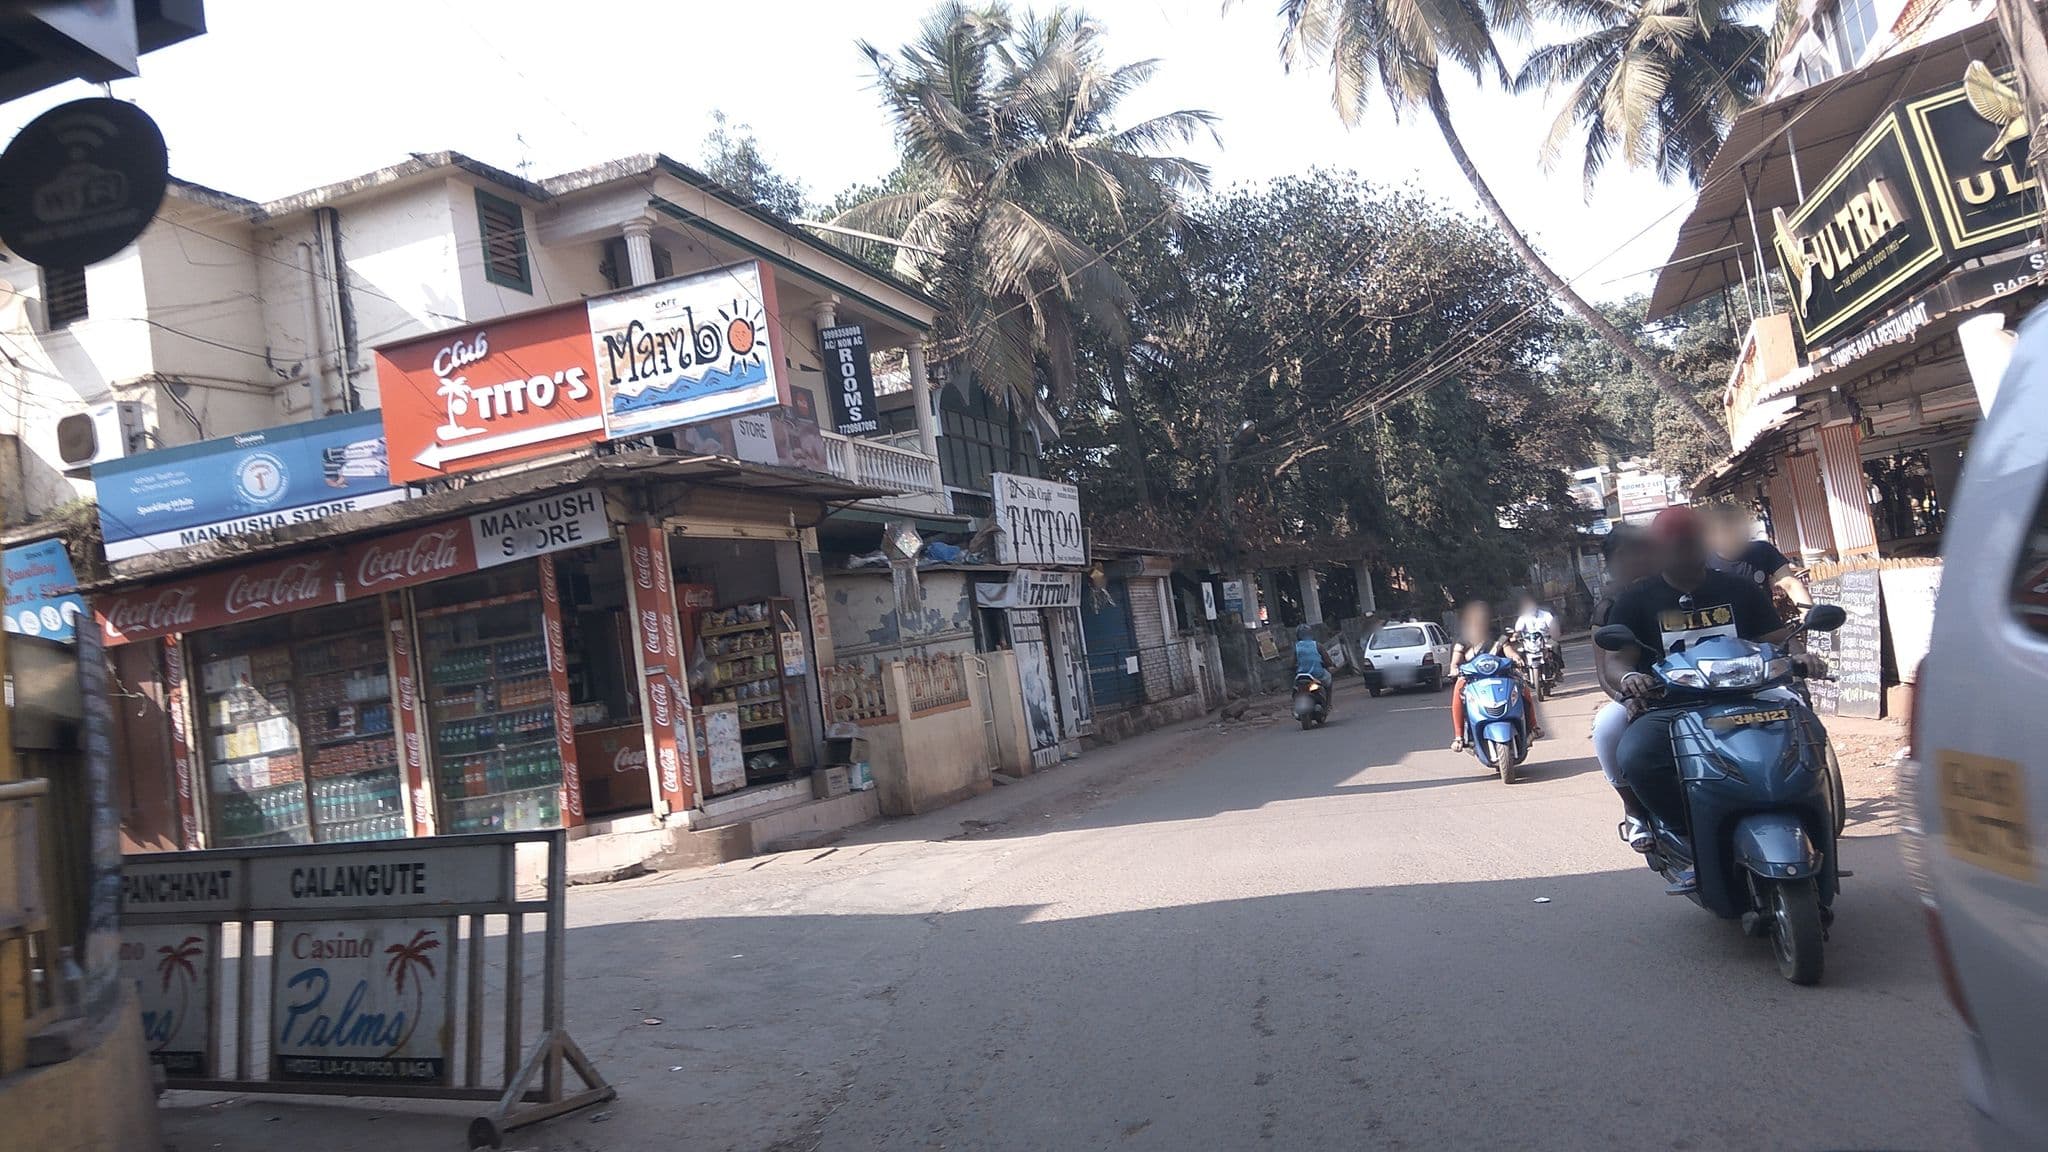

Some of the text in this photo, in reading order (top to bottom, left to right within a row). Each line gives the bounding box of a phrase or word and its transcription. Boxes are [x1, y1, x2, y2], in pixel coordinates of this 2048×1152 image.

[1811, 178, 1899, 280] ULTRA
[1842, 239, 1900, 288] THE EMPEROR OF GOOD TIMES
[603, 305, 757, 385] Mambo
[837, 338, 852, 348] NON
[853, 336, 864, 346] AC
[1877, 302, 1928, 344] RESTAURANT
[433, 331, 488, 377] Club
[471, 366, 590, 420] TITO'S
[839, 348, 863, 422] ROOMS
[738, 420, 768, 439] STORE
[180, 500, 358, 547] MANJUSHA STORE
[502, 520, 582, 557] SORE
[1006, 504, 1080, 564] TATTOO
[1029, 583, 1071, 606] TATTOO
[1058, 608, 1081, 733] TATTOO
[122, 869, 233, 901] PANCHAYAT
[290, 862, 427, 899] CALANGUTE
[292, 930, 375, 961] Casino
[281, 965, 406, 1047] Palms
